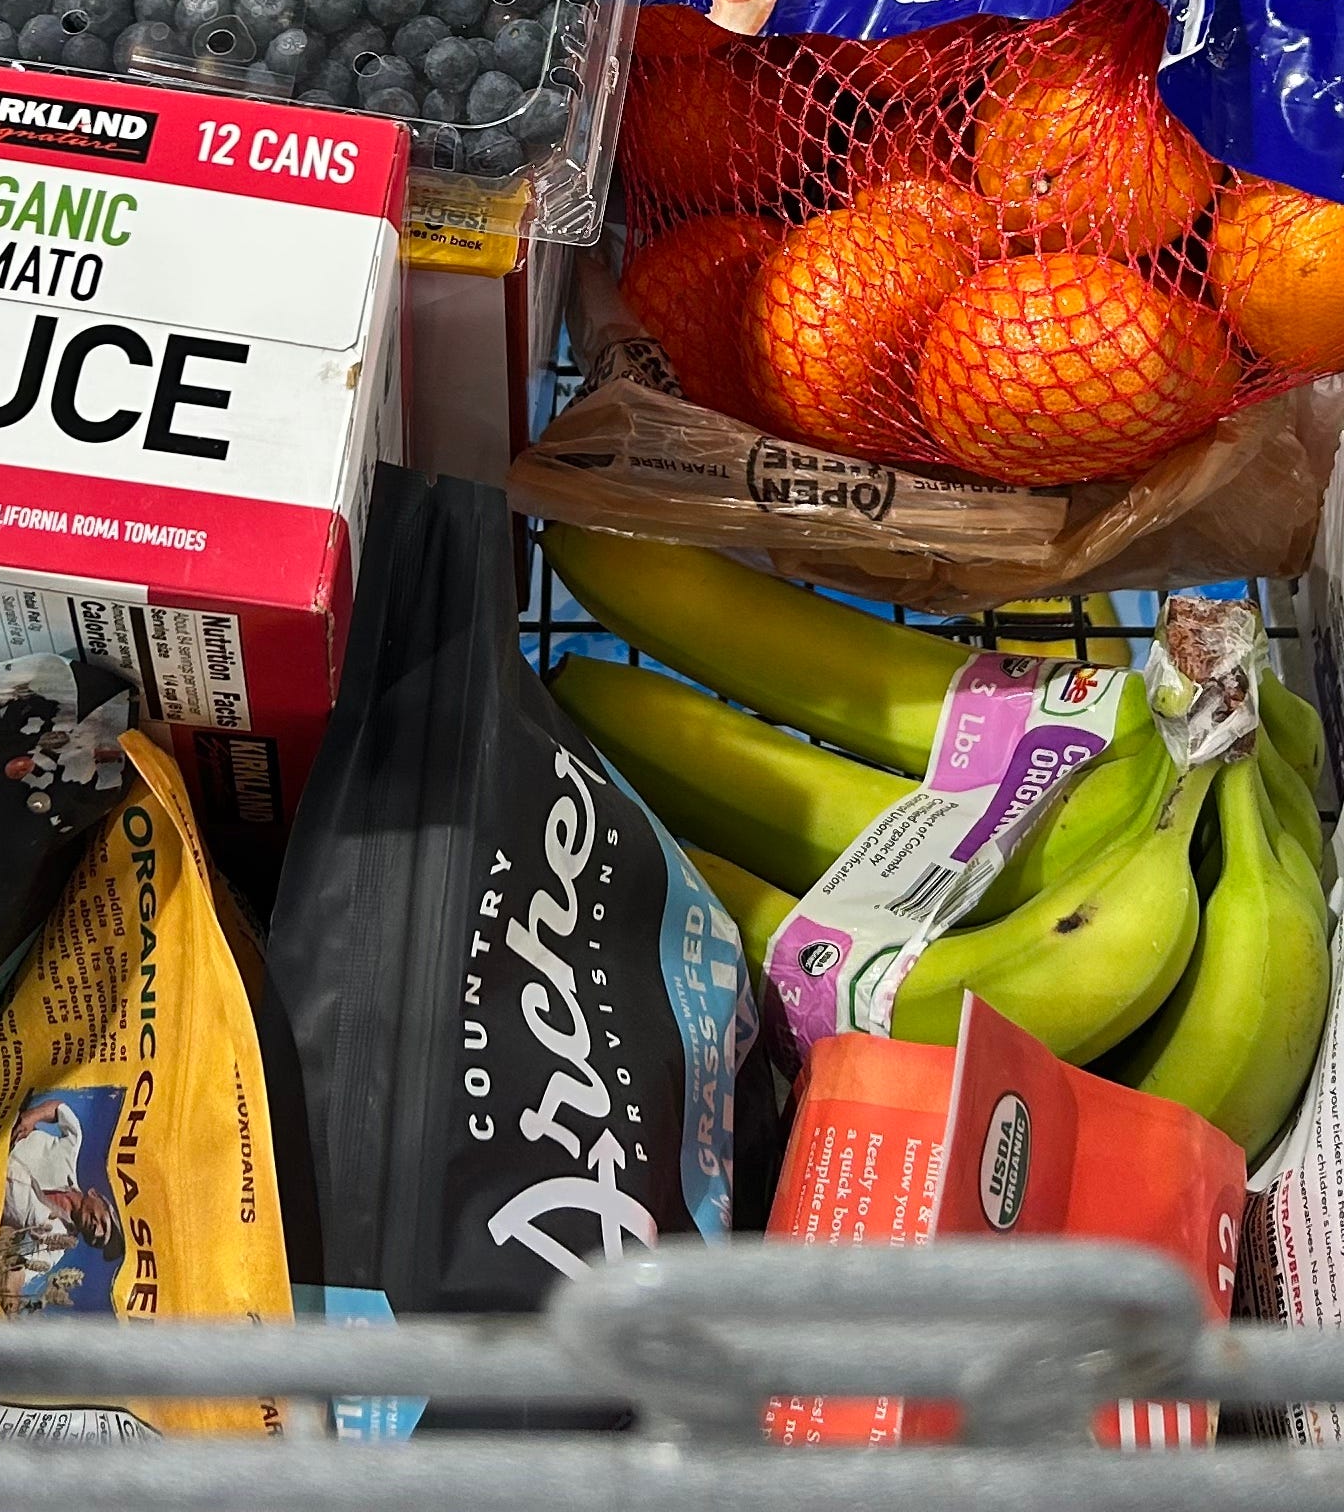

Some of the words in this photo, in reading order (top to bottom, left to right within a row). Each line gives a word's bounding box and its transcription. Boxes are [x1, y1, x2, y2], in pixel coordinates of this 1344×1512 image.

[197, 121, 241, 166] 12
[249, 129, 359, 185] CANS
[761, 477, 883, 513] OPEN
[71, 512, 120, 541] ROMA
[123, 520, 209, 553] TOMATOES
[81, 600, 109, 656] Calories
[202, 614, 232, 681] Nutrition
[212, 690, 242, 729] Facts
[969, 678, 995, 698] 3
[950, 713, 985, 770] Lbs
[122, 805, 158, 1061] ORGANIC
[463, 849, 513, 1143] COUNTRY
[588, 826, 649, 1163] PROVISIONS
[683, 904, 721, 1178] GRASS-FED
[116, 1070, 155, 1208] CHIA
[811, 1126, 837, 1210] complete
[859, 1133, 884, 1191] Ready
[900, 1138, 922, 1193] know
[989, 1119, 1013, 1198] USDA
[1003, 1116, 1027, 1216] ORGANIC
[857, 1195, 874, 1216] to
[1280, 1184, 1305, 1328] STRAWBERRY
